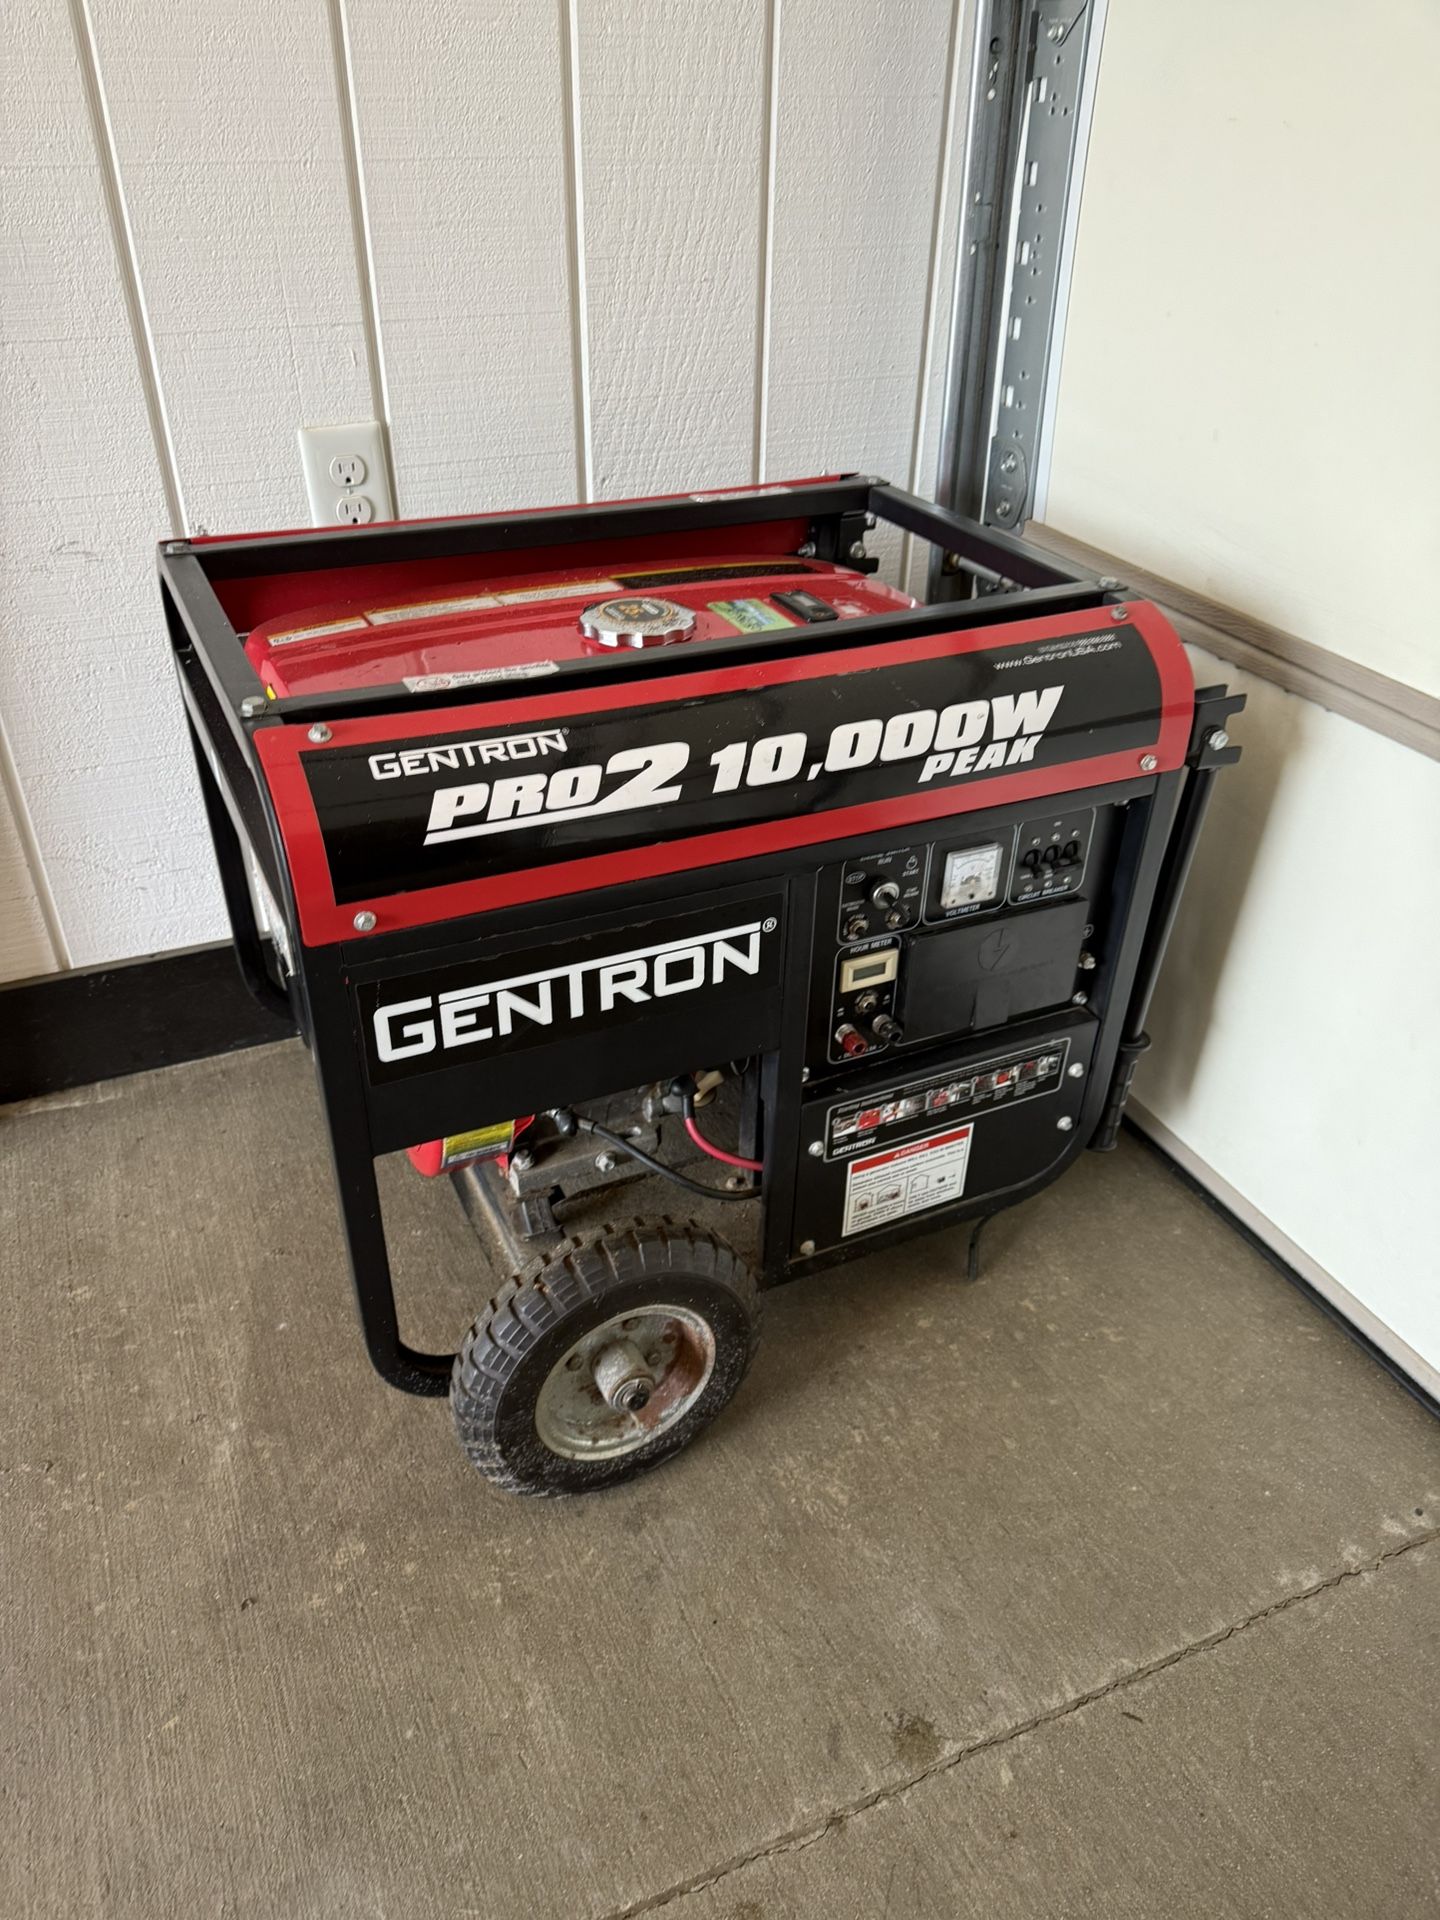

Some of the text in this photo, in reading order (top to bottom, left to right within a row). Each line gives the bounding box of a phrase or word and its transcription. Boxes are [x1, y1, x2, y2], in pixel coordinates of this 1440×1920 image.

[368, 728, 568, 781] GENTRON
[709, 685, 1065, 793] 10,000W
[918, 733, 1046, 784] PEAK
[945, 904, 981, 917] VOLTMETER
[850, 938, 893, 954] HOUR METER
[373, 921, 762, 1063] GENTRON
[832, 1137, 877, 1156] GENTRON
[900, 1142, 931, 1157] DANGER
